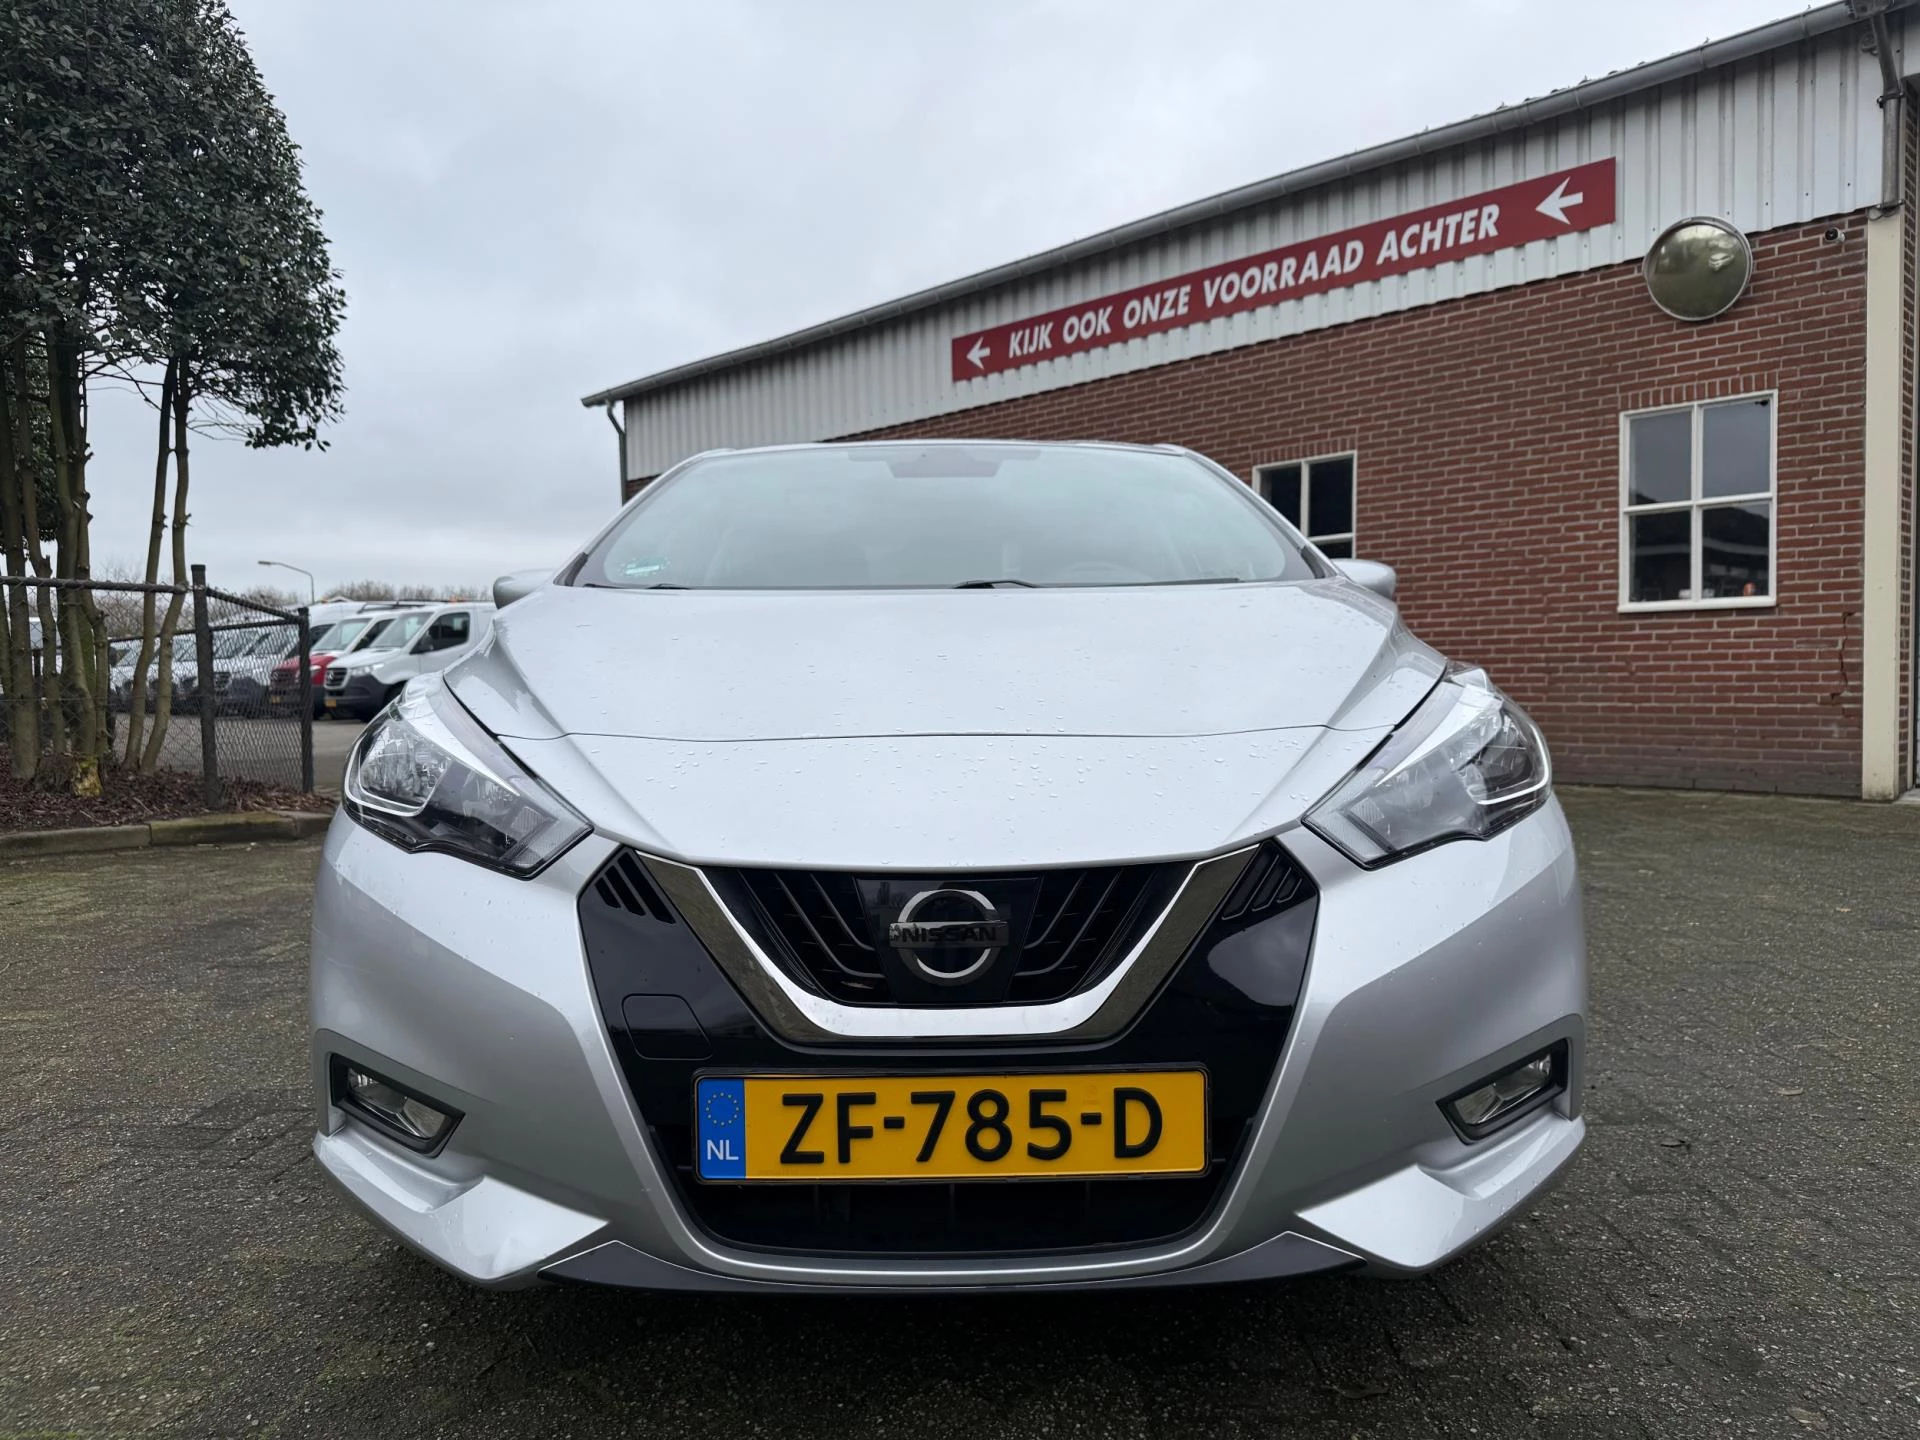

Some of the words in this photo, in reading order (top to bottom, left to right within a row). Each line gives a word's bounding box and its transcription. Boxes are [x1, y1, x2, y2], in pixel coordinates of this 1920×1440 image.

[1008, 323, 1052, 358] KIJK
[1062, 308, 1112, 344] OOK
[1123, 285, 1190, 327] ONZE
[1203, 240, 1363, 308] VOORRAAD
[1377, 204, 1500, 265] ACHTER
[903, 926, 998, 943] NISSAN
[706, 1139, 739, 1161] NL
[780, 1087, 1163, 1164] ZF-785-D
